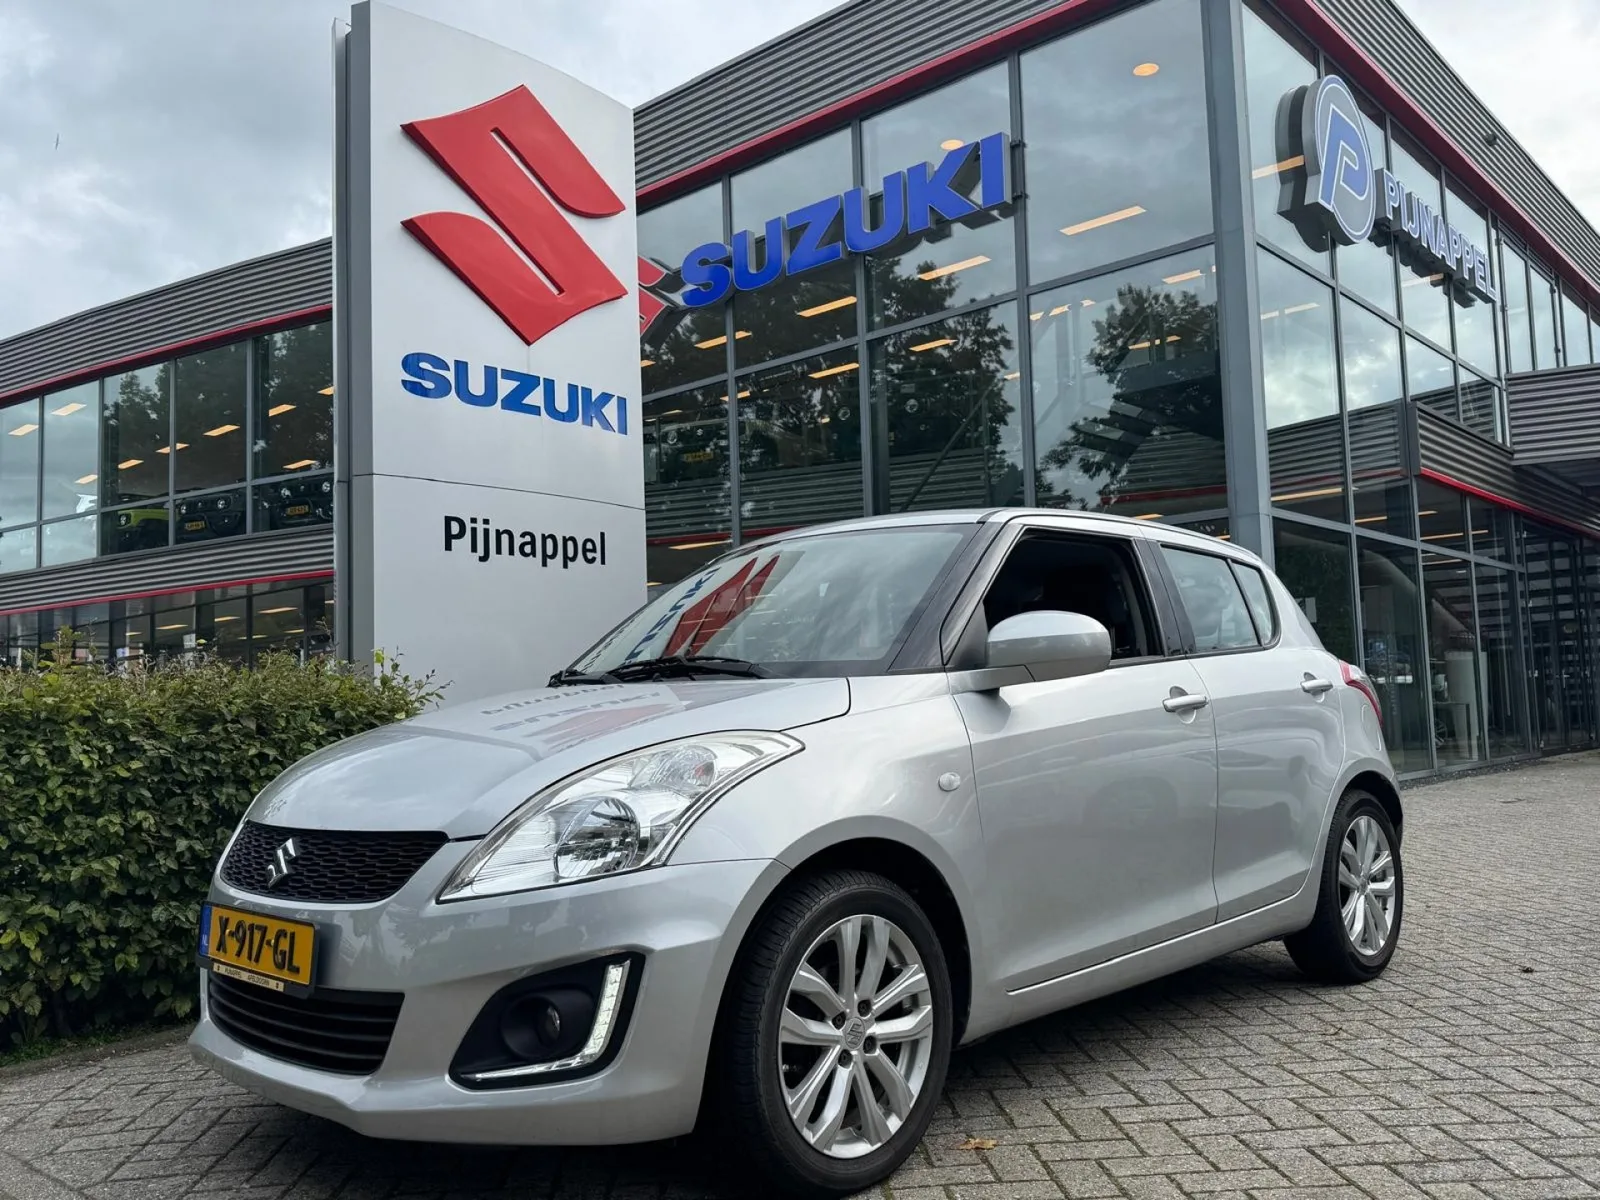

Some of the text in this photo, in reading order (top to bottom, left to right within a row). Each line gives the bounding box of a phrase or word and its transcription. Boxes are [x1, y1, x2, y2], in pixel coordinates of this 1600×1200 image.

[681, 132, 1010, 307] SUZUKI
[1383, 168, 1497, 301] PIJNAPPEL
[401, 352, 628, 435] SUZUKI
[443, 515, 606, 569] Pijnappel
[216, 915, 300, 975] X-917-GL
